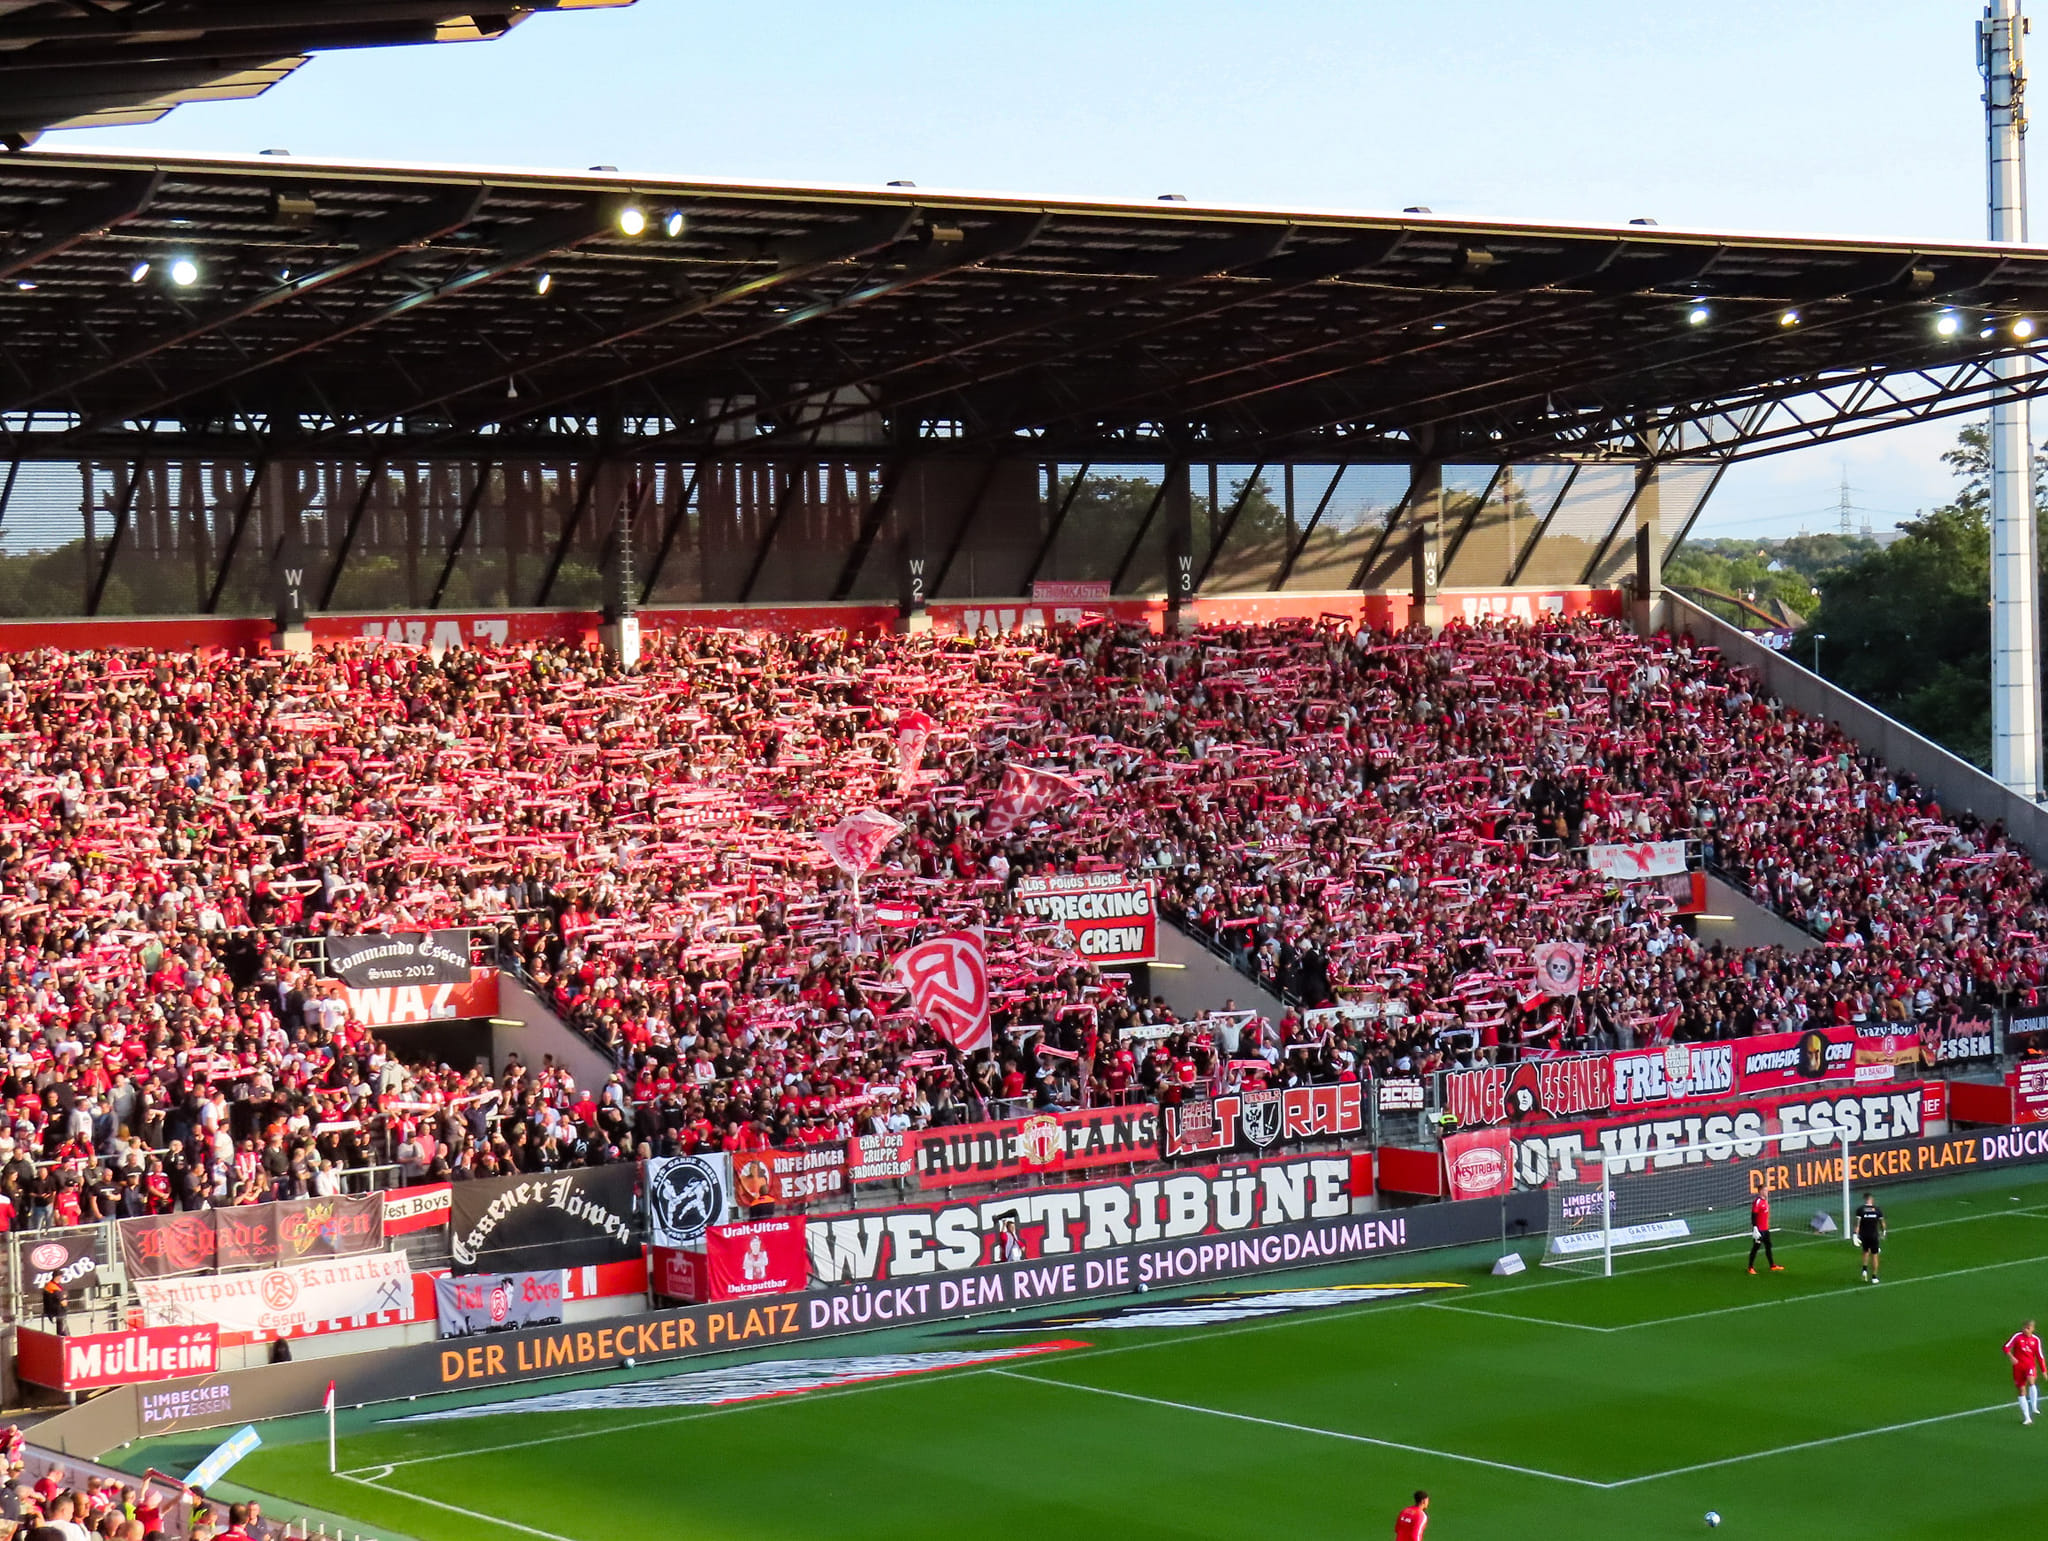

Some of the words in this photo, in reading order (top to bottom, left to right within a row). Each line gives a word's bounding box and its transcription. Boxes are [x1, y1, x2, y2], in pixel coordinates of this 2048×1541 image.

[909, 559, 924, 575] W
[1179, 556, 1192, 571] W
[1424, 551, 1437, 566] W
[285, 568, 303, 586] W
[1182, 573, 1191, 591] 3
[1426, 568, 1436, 586] 3
[912, 578, 923, 596] 2
[290, 589, 299, 609] 1
[1023, 890, 1150, 921] WRECKING
[1079, 927, 1144, 955] CREW
[331, 940, 414, 974] Commando
[418, 941, 467, 969] Essen
[368, 967, 402, 981] Since
[405, 965, 435, 978] 2012
[1937, 1036, 1992, 1060] ESSEN
[1746, 1048, 1800, 1075] NORTHSIDE
[1825, 1042, 1853, 1061] CREW
[1540, 1056, 1611, 1117] ESSENER
[1779, 1090, 1924, 1152] ESSEN
[884, 1134, 904, 1147] DER
[922, 1126, 1021, 1177] RUDE
[1063, 1112, 1157, 1160] FANS
[863, 1148, 898, 1163] GRUPPE
[1749, 1165, 1790, 1195] DER
[1796, 1148, 1913, 1188] LIMBECKER
[1918, 1139, 1978, 1170] PLATZ
[780, 1169, 841, 1198] ESSEN
[413, 1195, 449, 1214] Boys
[1562, 1190, 1616, 1207] LIMBECKR
[806, 1158, 1350, 1281] WESTTRIBÜNE
[723, 1221, 790, 1239] Uralt-Ultras
[728, 1278, 787, 1294] Unkaputtbar
[441, 1344, 505, 1382] DER
[518, 1317, 695, 1371] LIMBECKER
[708, 1302, 800, 1342] PLATZ
[810, 1284, 931, 1329] DRÜCKT
[940, 1272, 1004, 1311] DEM
[1014, 1263, 1076, 1298] RWE
[1086, 1256, 1129, 1290] DIE
[1139, 1217, 1407, 1282] SHOPPINGDAUMEN!
[257, 1310, 306, 1328] Essen
[143, 1385, 230, 1409] LIMBECKER
